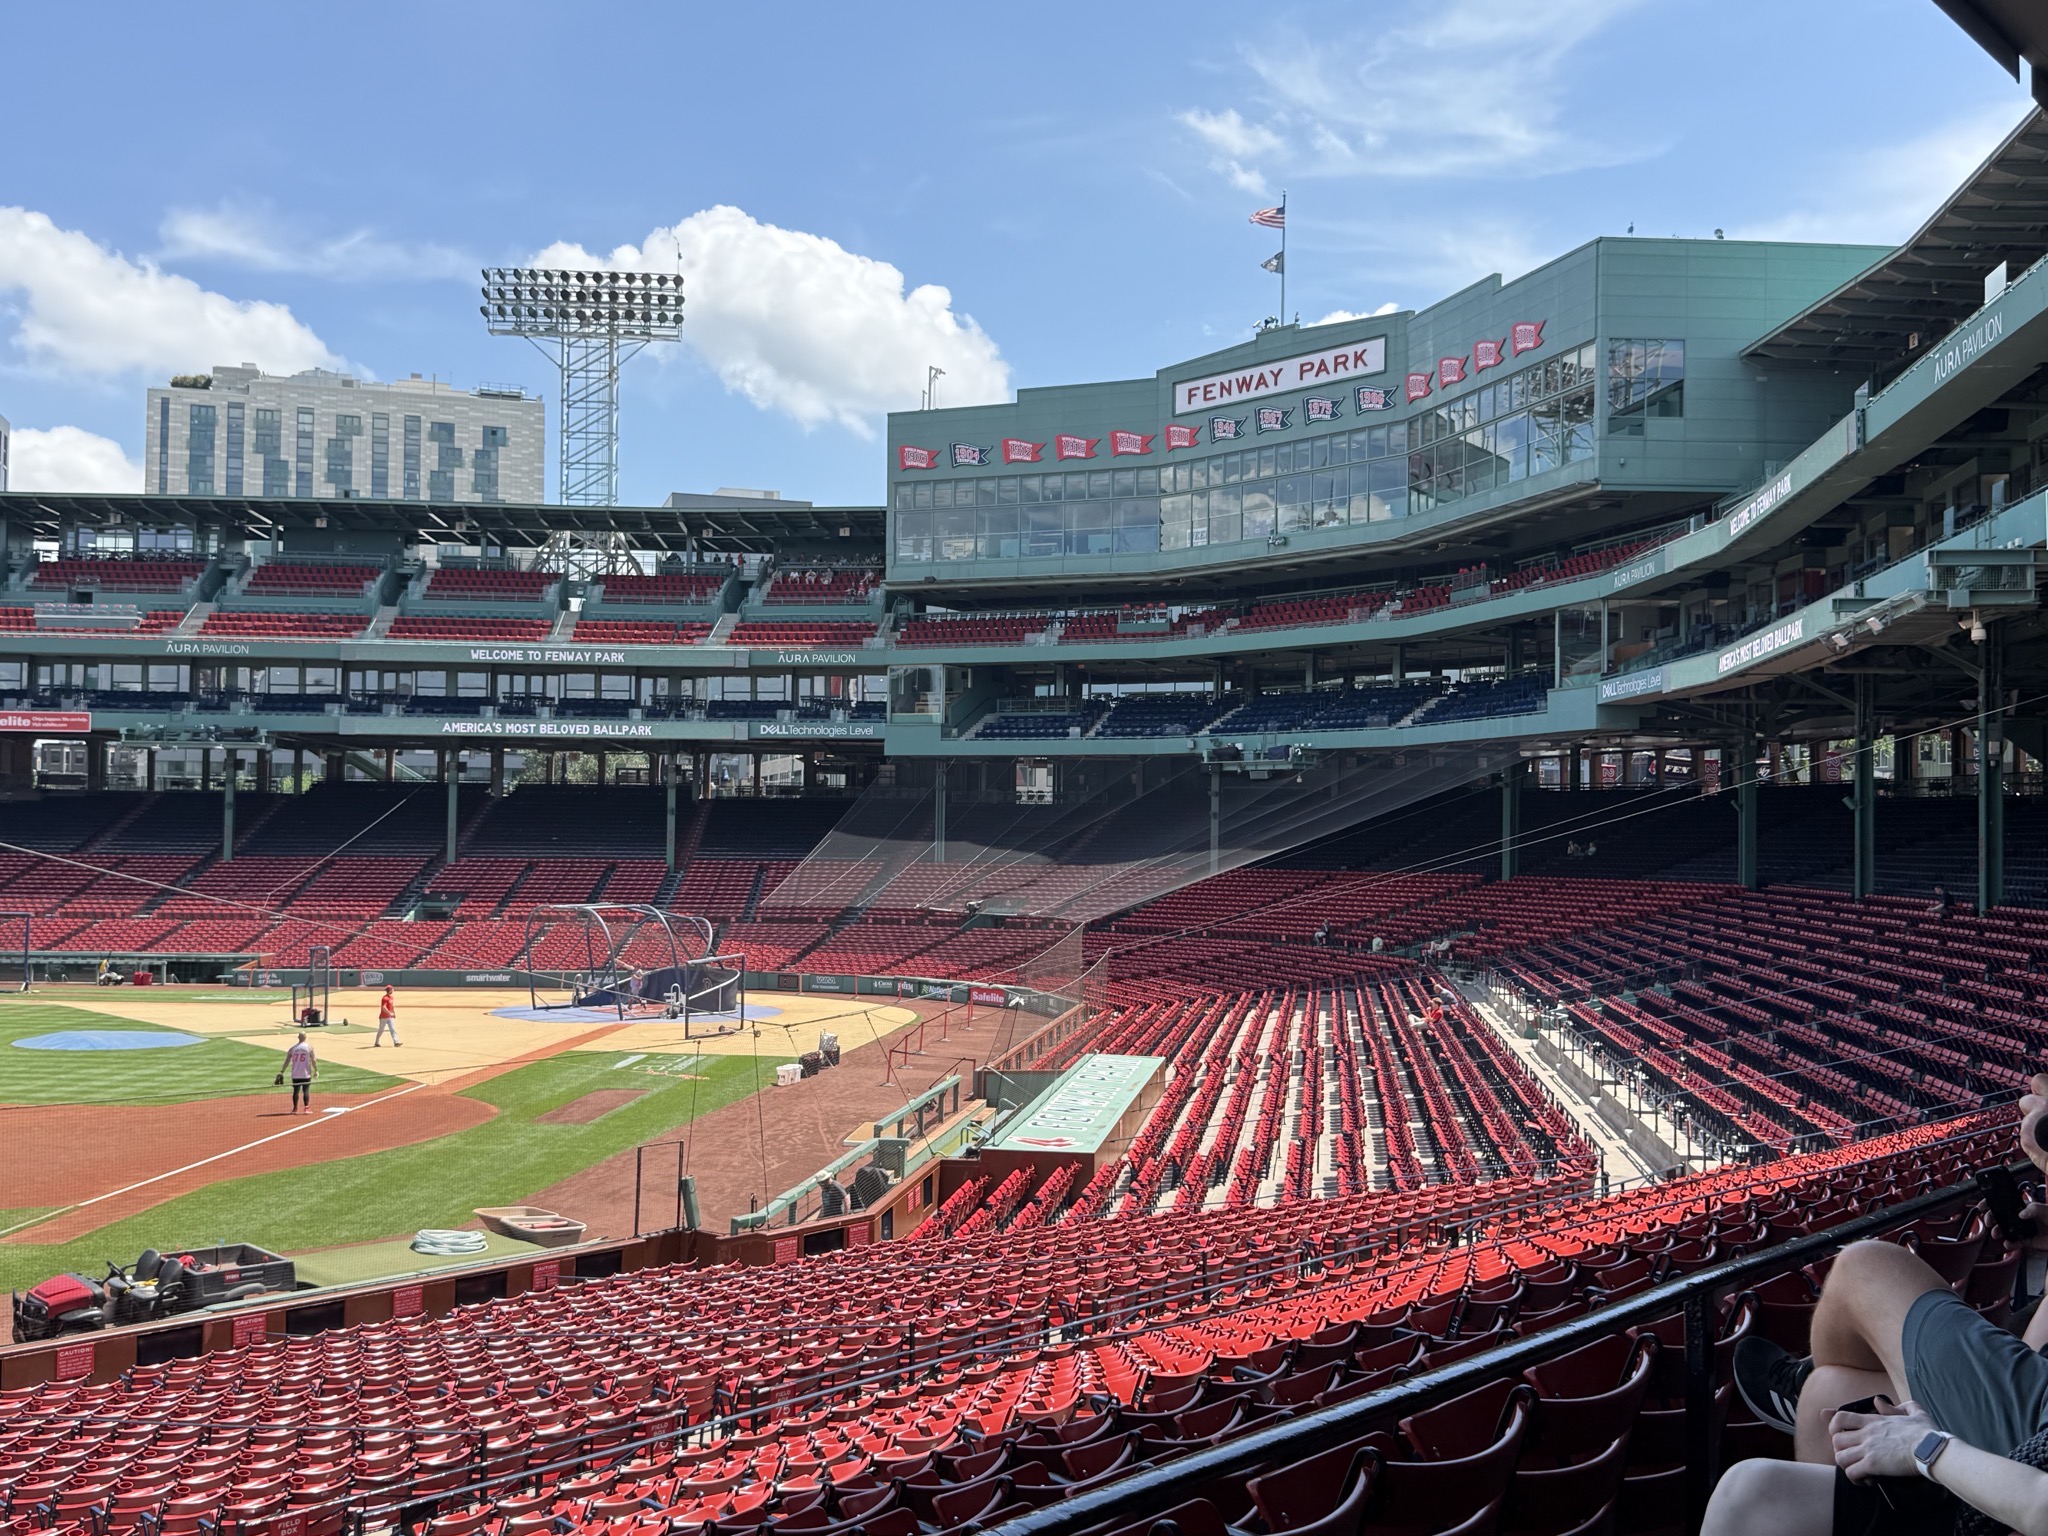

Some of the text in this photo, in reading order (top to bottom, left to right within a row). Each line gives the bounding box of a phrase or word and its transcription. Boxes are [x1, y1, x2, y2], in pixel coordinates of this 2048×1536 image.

[1962, 312, 2003, 363] PAVILION
[1187, 348, 1368, 405] FENWAY PARK
[1308, 402, 1332, 416] 1975
[1260, 411, 1282, 426] 1967
[955, 448, 979, 461] 1904
[1730, 472, 1791, 537] WELCOME TO FENWAY PARK
[1631, 561, 1655, 584] PAVILION
[1740, 643, 1752, 664] MOST
[1753, 632, 1774, 658] BELOVED
[1775, 619, 1803, 649] BALLPARK
[202, 644, 250, 655] PAVILION
[471, 650, 625, 662] WELCOME TO FENWAY PARK
[812, 654, 856, 663] PAVILION
[1616, 675, 1647, 696] Technologies
[1647, 672, 1662, 688] Level
[0, 716, 31, 727] elite
[442, 722, 652, 736] AMERICA'S MOST BELOVED BALLPARK
[760, 724, 874, 737] DELL Technologies Level
[466, 974, 511, 982] smartwater
[972, 991, 1005, 1003] Safelite
[1027, 1081, 1122, 1132] FENWAY
[1110, 1315, 1121, 1326] 73
[60, 1347, 93, 1357] CAUTION!
[776, 1390, 791, 1398] FIELD
[776, 1405, 791, 1417] 75
[652, 1422, 669, 1431] FIELD
[278, 1519, 301, 1530] FIELD
[281, 1527, 298, 1536] BOX
